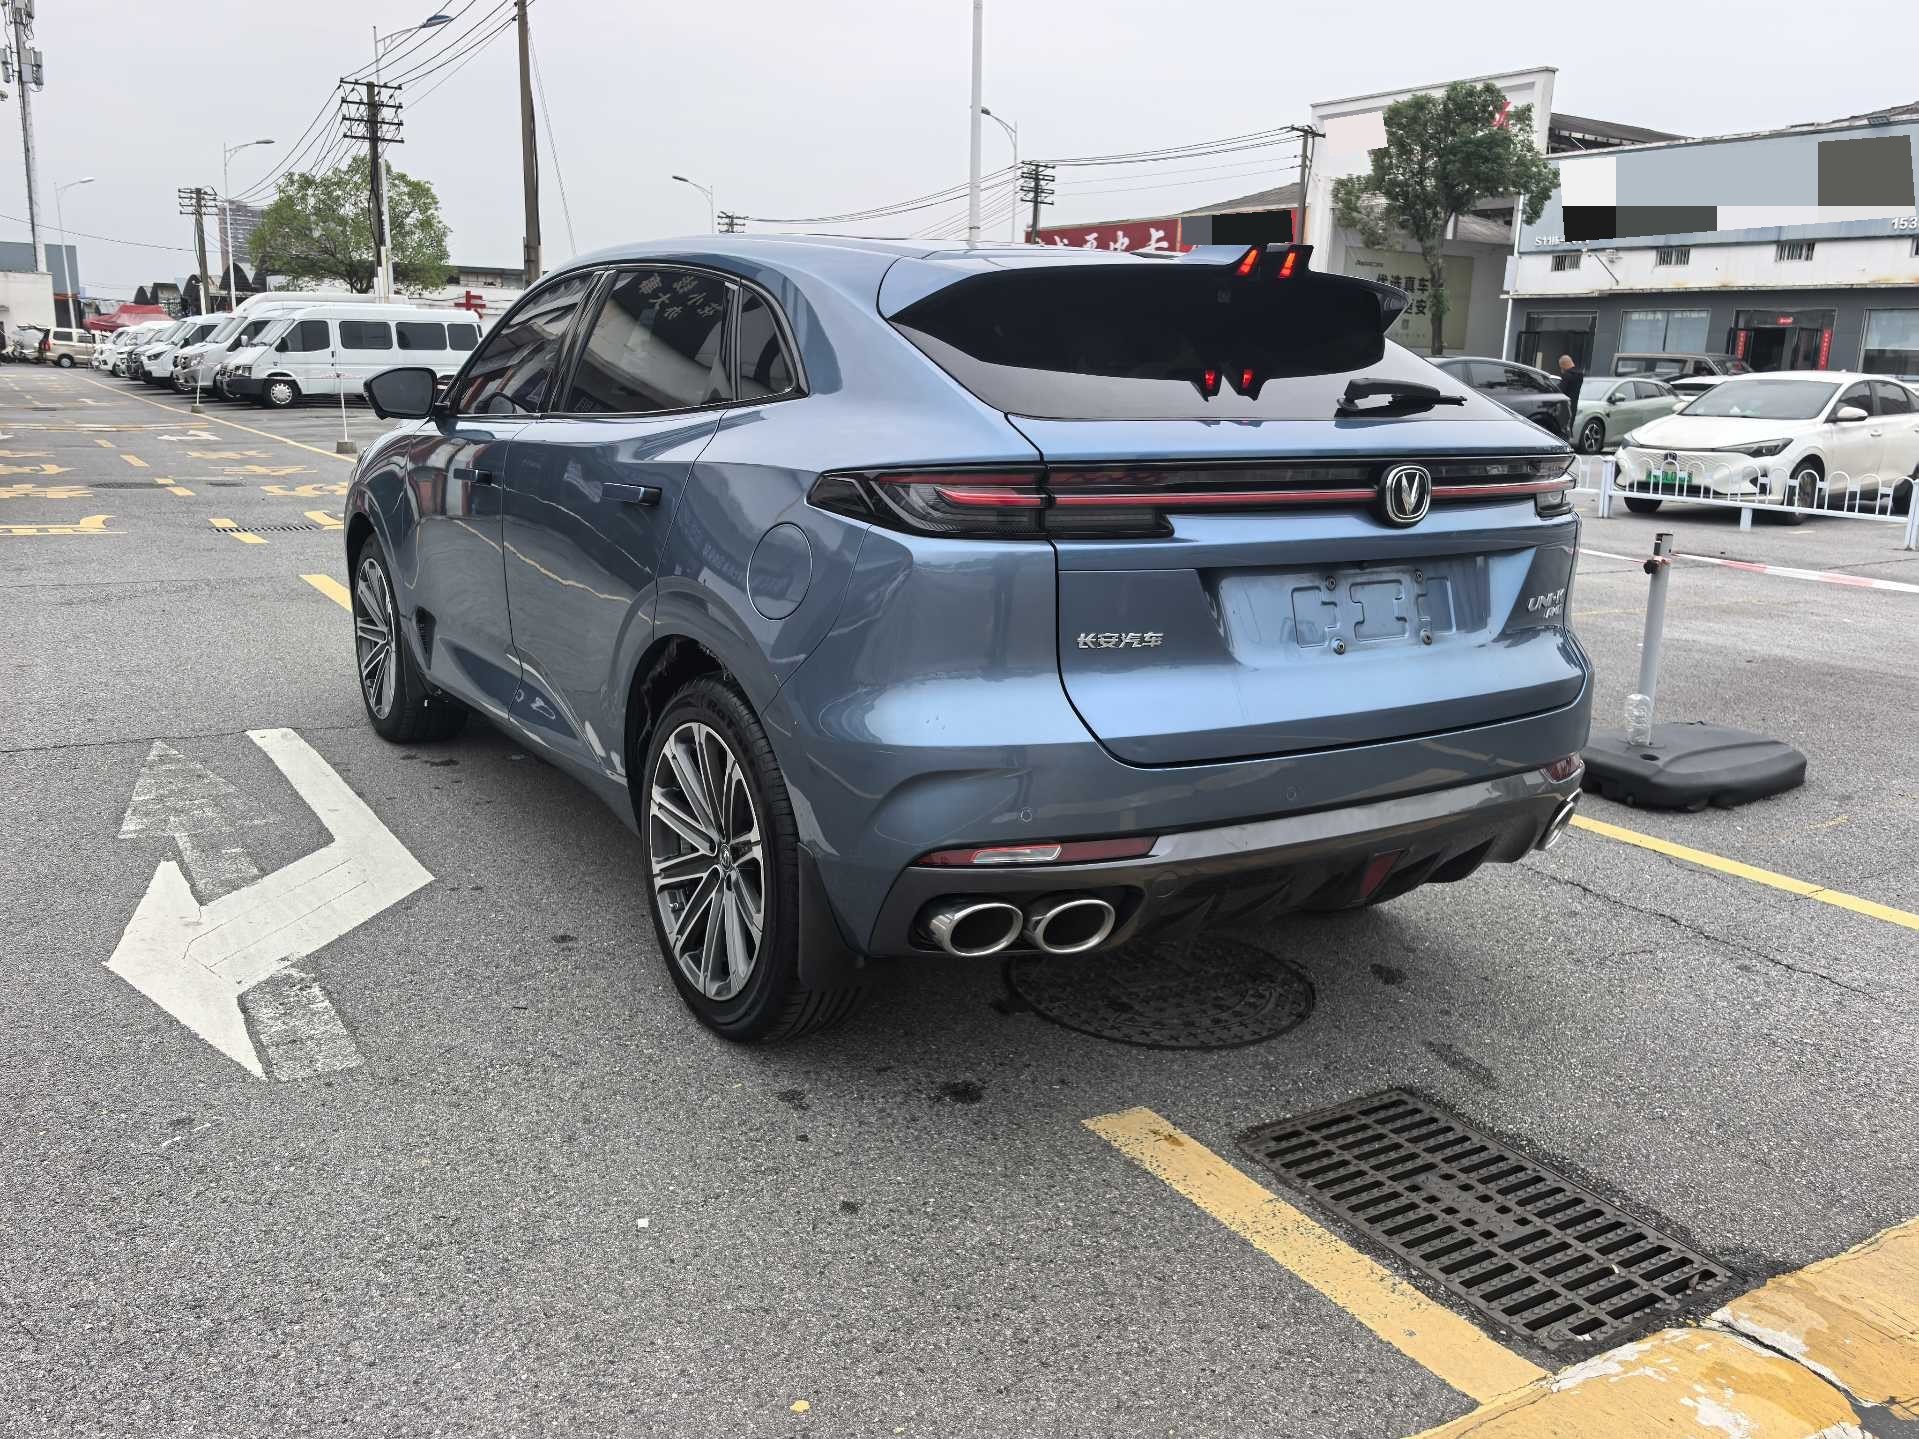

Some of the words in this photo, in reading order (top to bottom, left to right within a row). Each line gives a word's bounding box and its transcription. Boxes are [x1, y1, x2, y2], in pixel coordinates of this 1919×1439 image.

[1891, 216, 1919, 230] 153
[1076, 631, 1164, 649] 长安汽车
